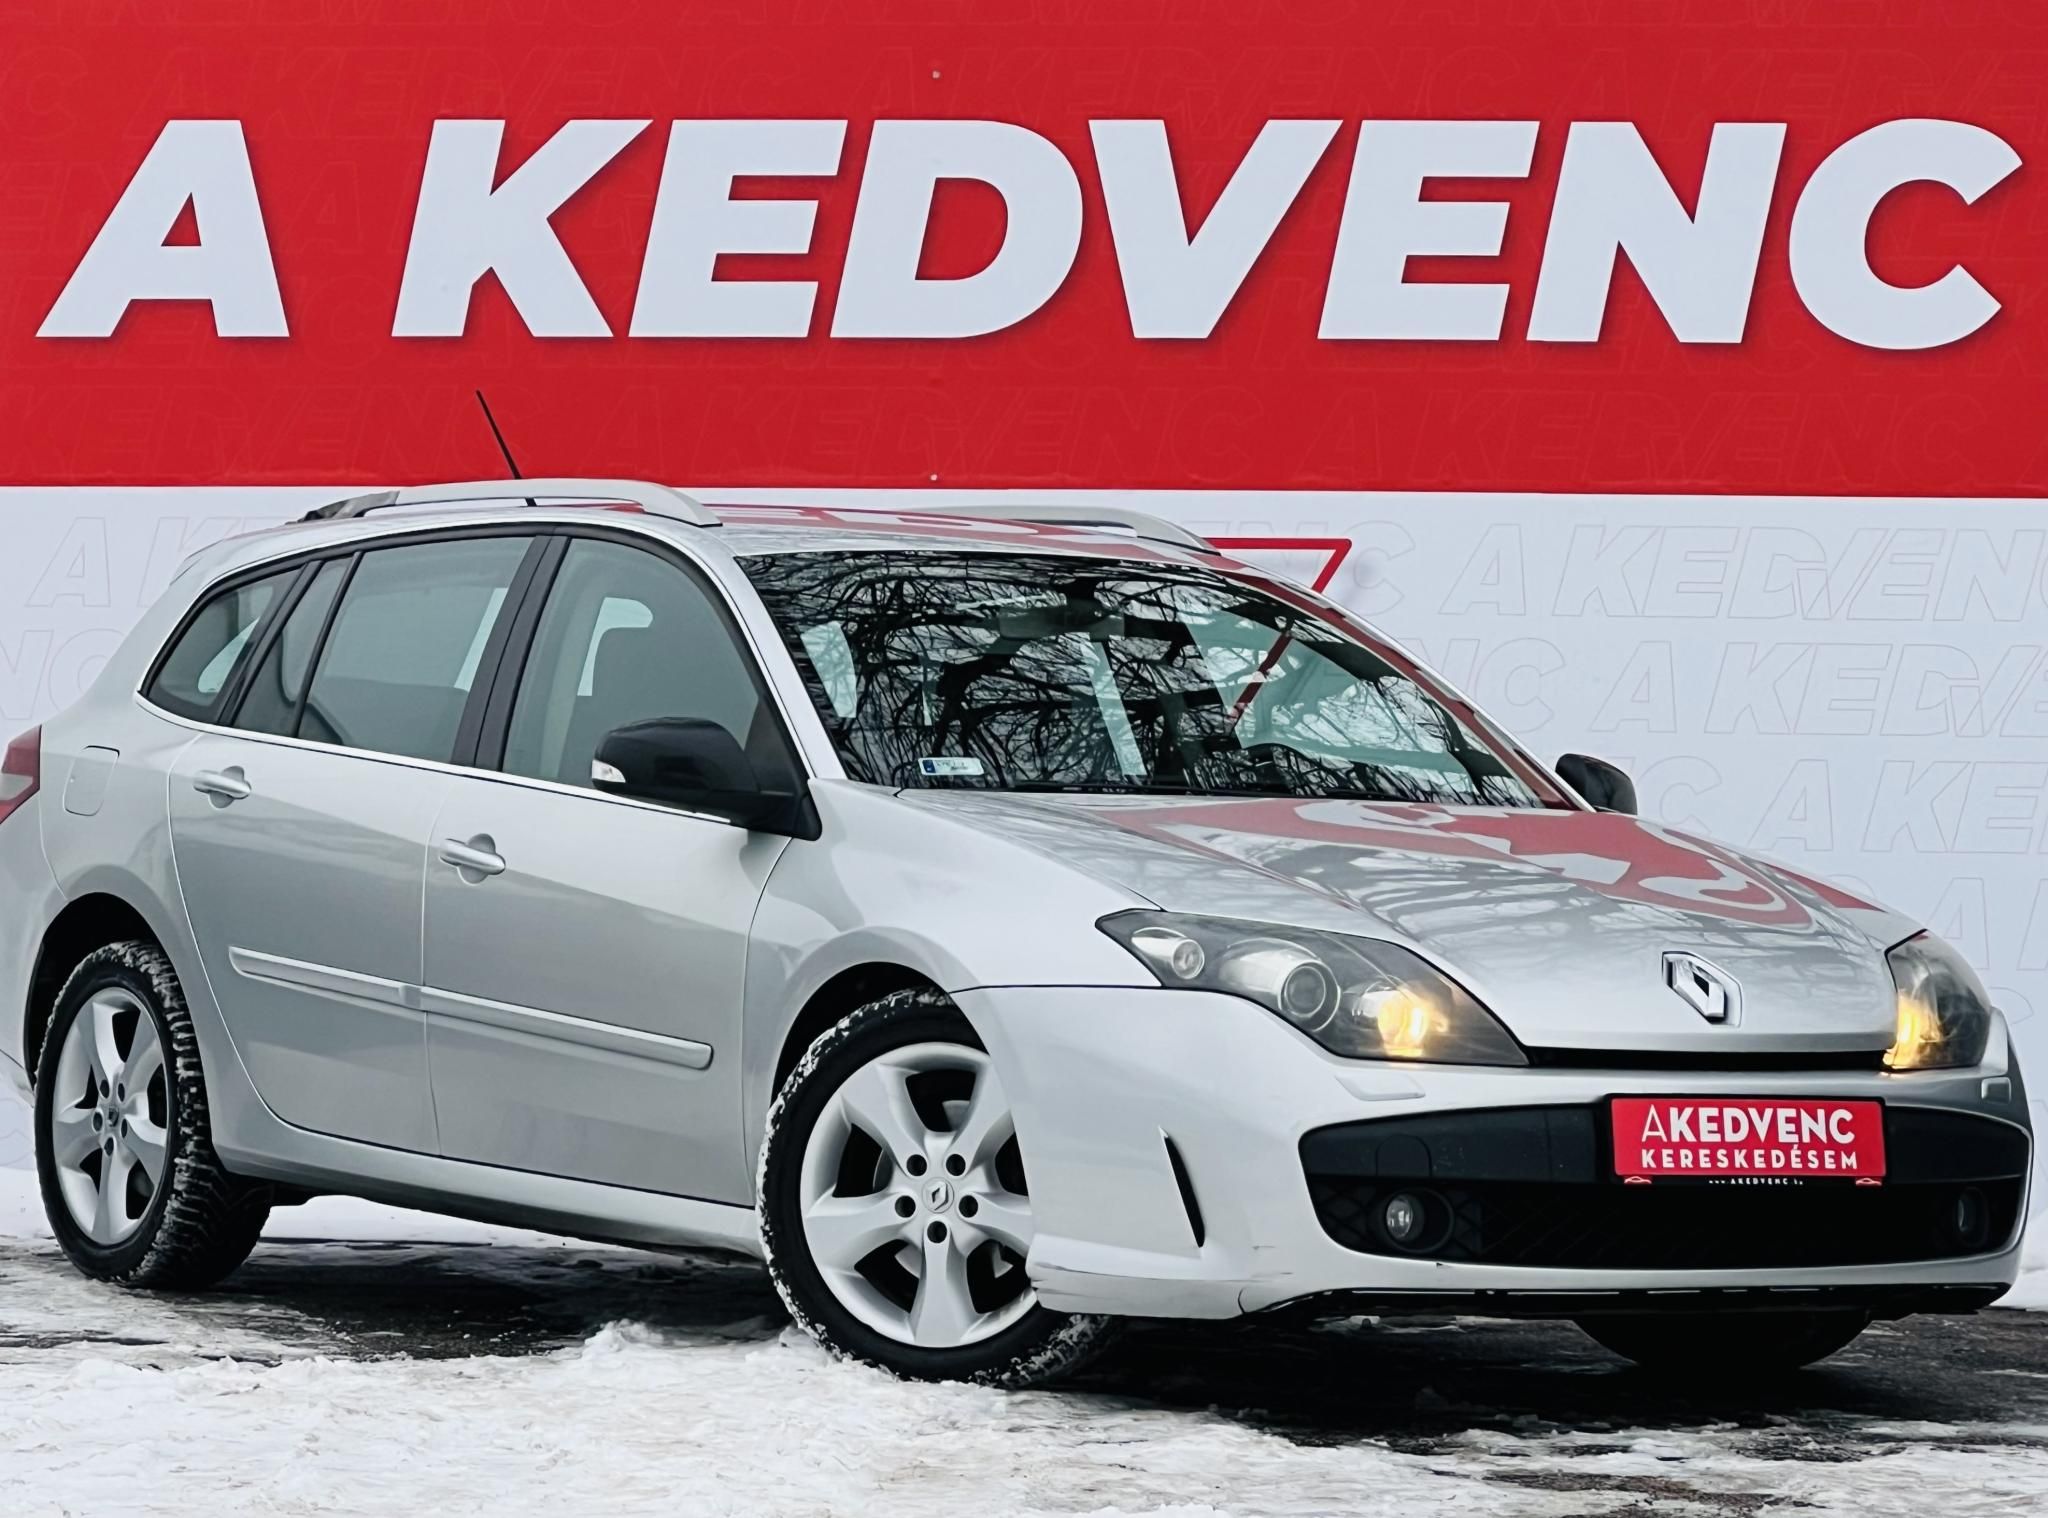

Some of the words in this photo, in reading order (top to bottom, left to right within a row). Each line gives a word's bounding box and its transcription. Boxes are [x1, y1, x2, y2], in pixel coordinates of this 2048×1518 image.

[37, 118, 290, 339] A
[391, 117, 2024, 350] KEDVENC
[1551, 524, 2048, 622] KEDVEN
[1641, 1104, 1855, 1145] AKEDVENC
[1641, 1144, 1858, 1170] KERESKEDÉSEM
